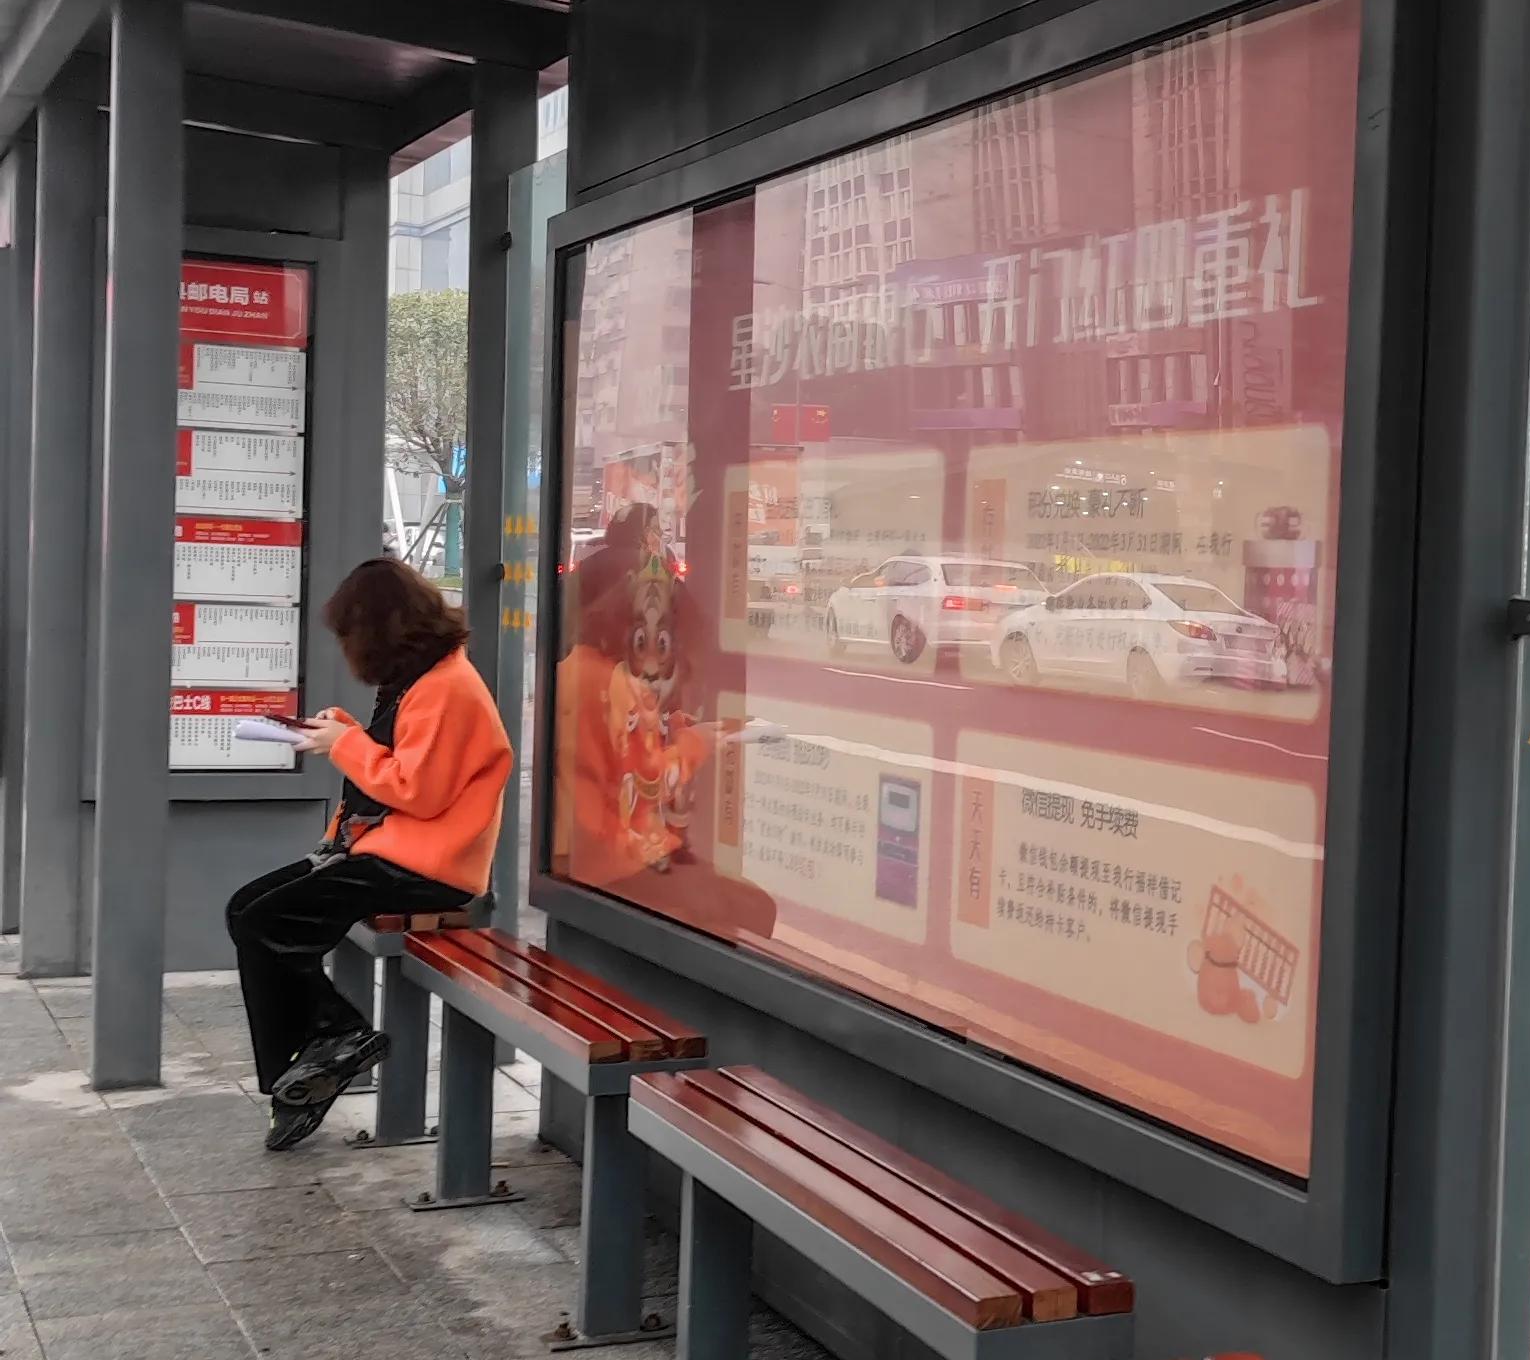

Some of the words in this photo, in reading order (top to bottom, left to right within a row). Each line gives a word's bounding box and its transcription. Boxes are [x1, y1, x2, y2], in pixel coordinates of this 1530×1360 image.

[1021, 788, 1075, 825] 微信提现
[1080, 799, 1140, 840] 免手续费
